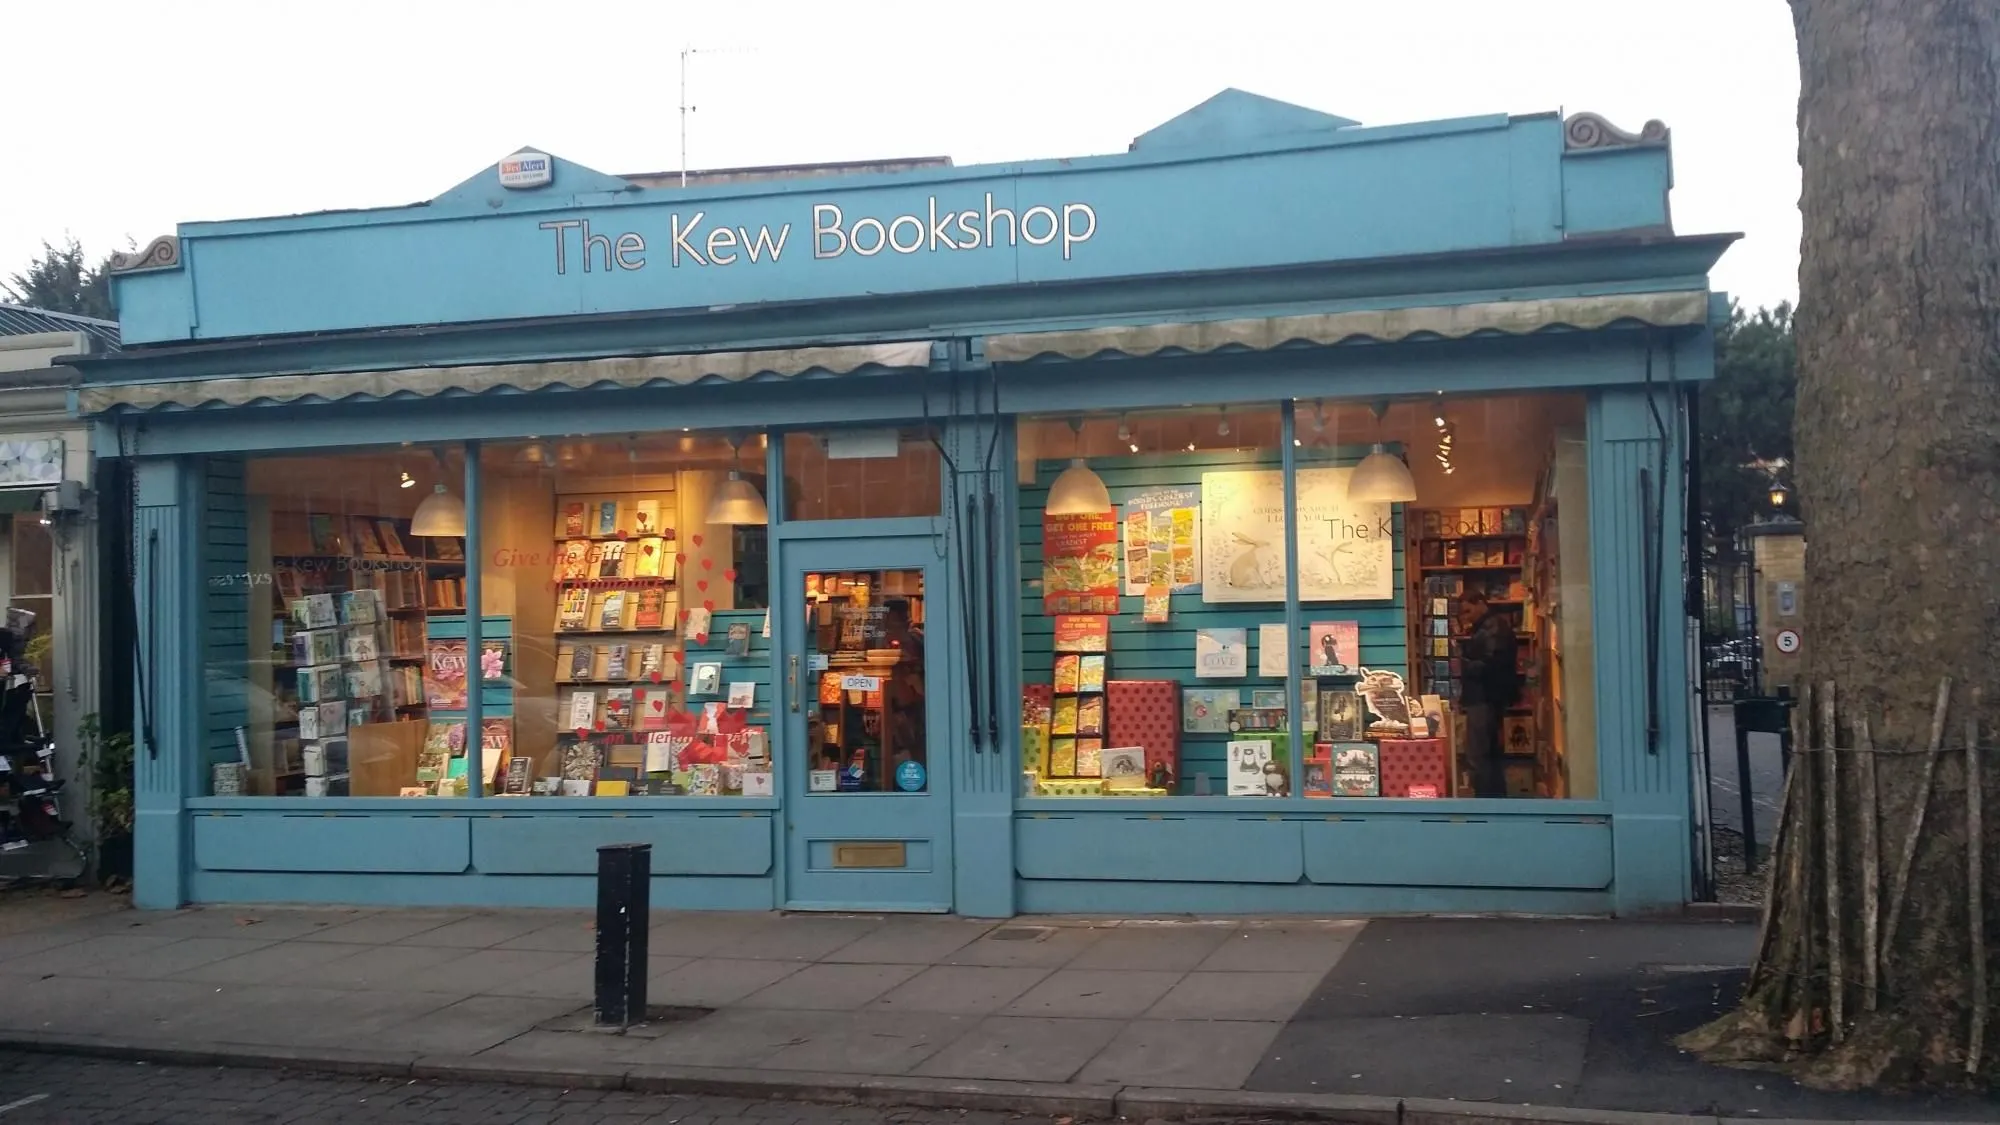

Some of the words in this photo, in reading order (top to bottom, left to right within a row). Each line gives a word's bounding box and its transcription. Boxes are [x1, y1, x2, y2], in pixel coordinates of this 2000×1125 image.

[523, 160, 544, 170] Alert
[538, 217, 647, 275] The
[670, 211, 793, 267] Kew
[811, 191, 1098, 260] Bookshop
[1046, 522, 1064, 532] GET
[1067, 522, 1089, 532] ONE
[1091, 520, 1115, 531] FREE
[1325, 517, 1368, 541] The
[493, 548, 540, 568] Give
[584, 544, 625, 567] Gift
[291, 555, 331, 573] Kew
[336, 557, 425, 573] Bookshop
[1784, 636, 1792, 647] 5
[431, 652, 467, 671] Kew
[1203, 654, 1238, 667] LOVE
[847, 678, 873, 688] OPEN
[482, 734, 507, 748] ew
